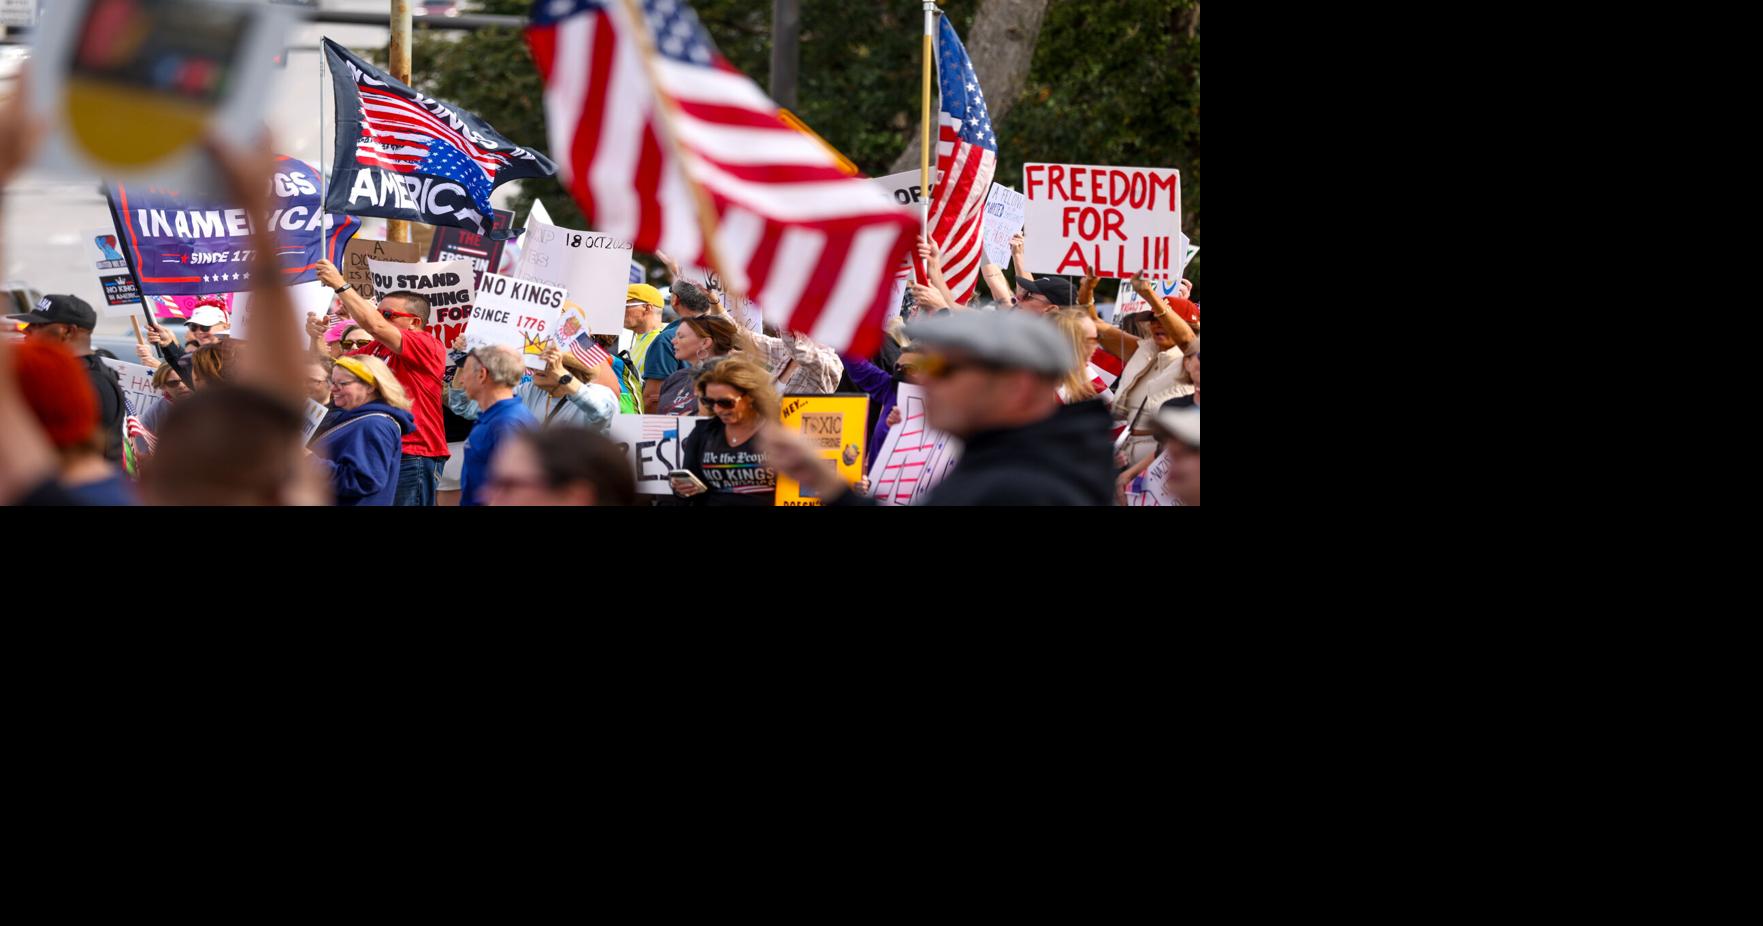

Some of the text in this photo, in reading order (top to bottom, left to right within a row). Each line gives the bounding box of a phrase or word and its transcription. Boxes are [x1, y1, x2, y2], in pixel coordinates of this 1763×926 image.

[1025, 165, 1177, 212] FREEDOM
[137, 206, 335, 239] IN AMEICA
[1062, 206, 1128, 241] FOR
[374, 241, 385, 255] A
[566, 233, 582, 248] 18
[190, 250, 258, 265] SINCE 177
[1056, 236, 1170, 280] ALL!!!
[350, 271, 362, 280] IS
[396, 273, 460, 290] STAND
[119, 284, 139, 294] KING
[481, 275, 506, 296] NO
[510, 282, 563, 309] KINGS
[472, 306, 546, 332] SINCE 1776
[703, 467, 775, 481] NO KINGS
